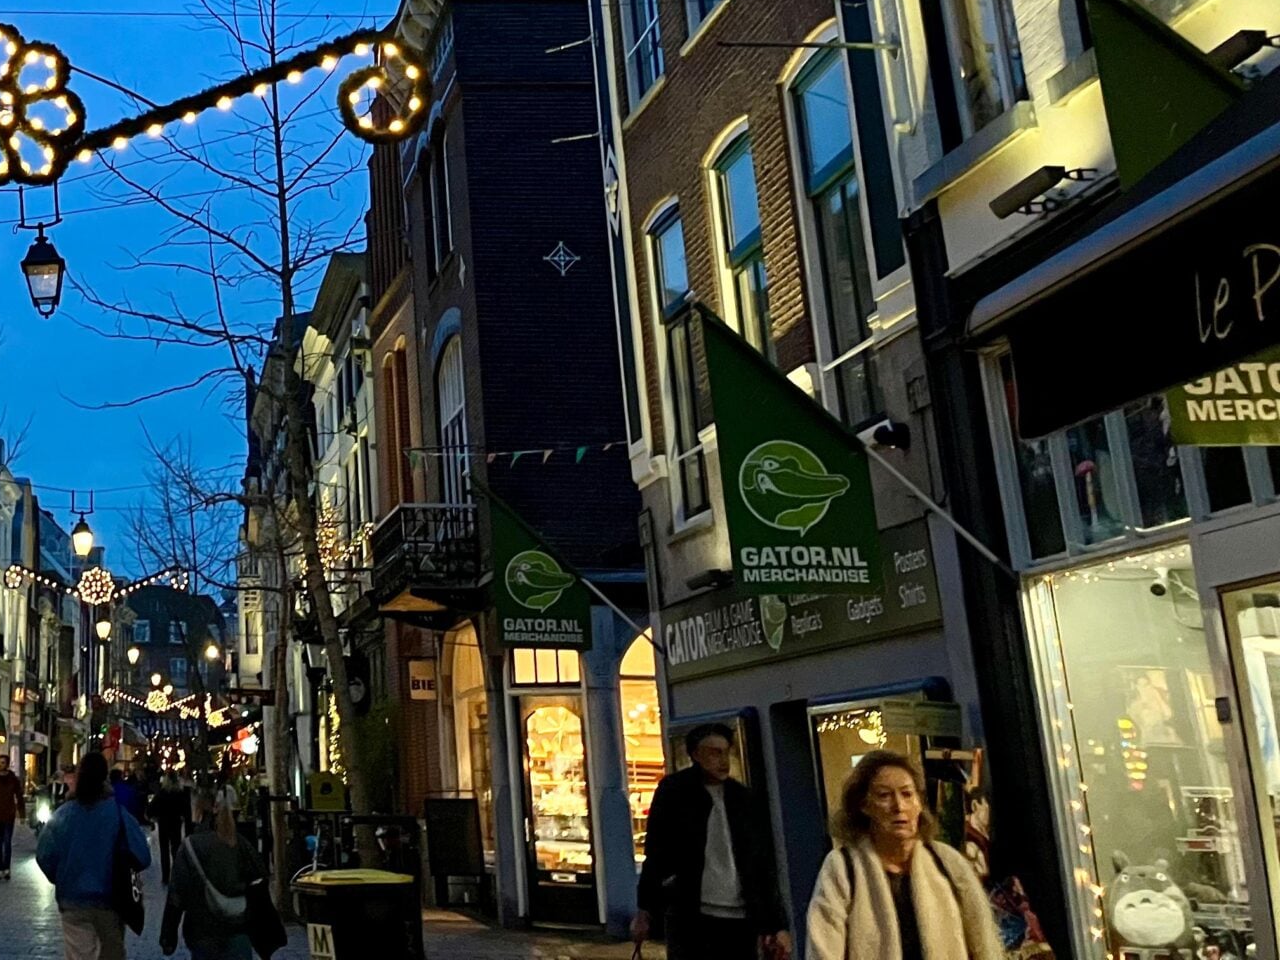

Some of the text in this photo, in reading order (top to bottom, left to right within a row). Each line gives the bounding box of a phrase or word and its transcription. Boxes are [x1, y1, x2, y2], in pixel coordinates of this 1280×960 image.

[740, 546, 868, 567] GATOR.NL
[743, 568, 870, 583] MERCHANDISE
[729, 598, 755, 626] GAME
[503, 618, 584, 633] GATOR.NL
[504, 632, 584, 643] MERCHANDISE
[666, 615, 709, 666] GATOR
[707, 620, 763, 656] MERCHANDISE
